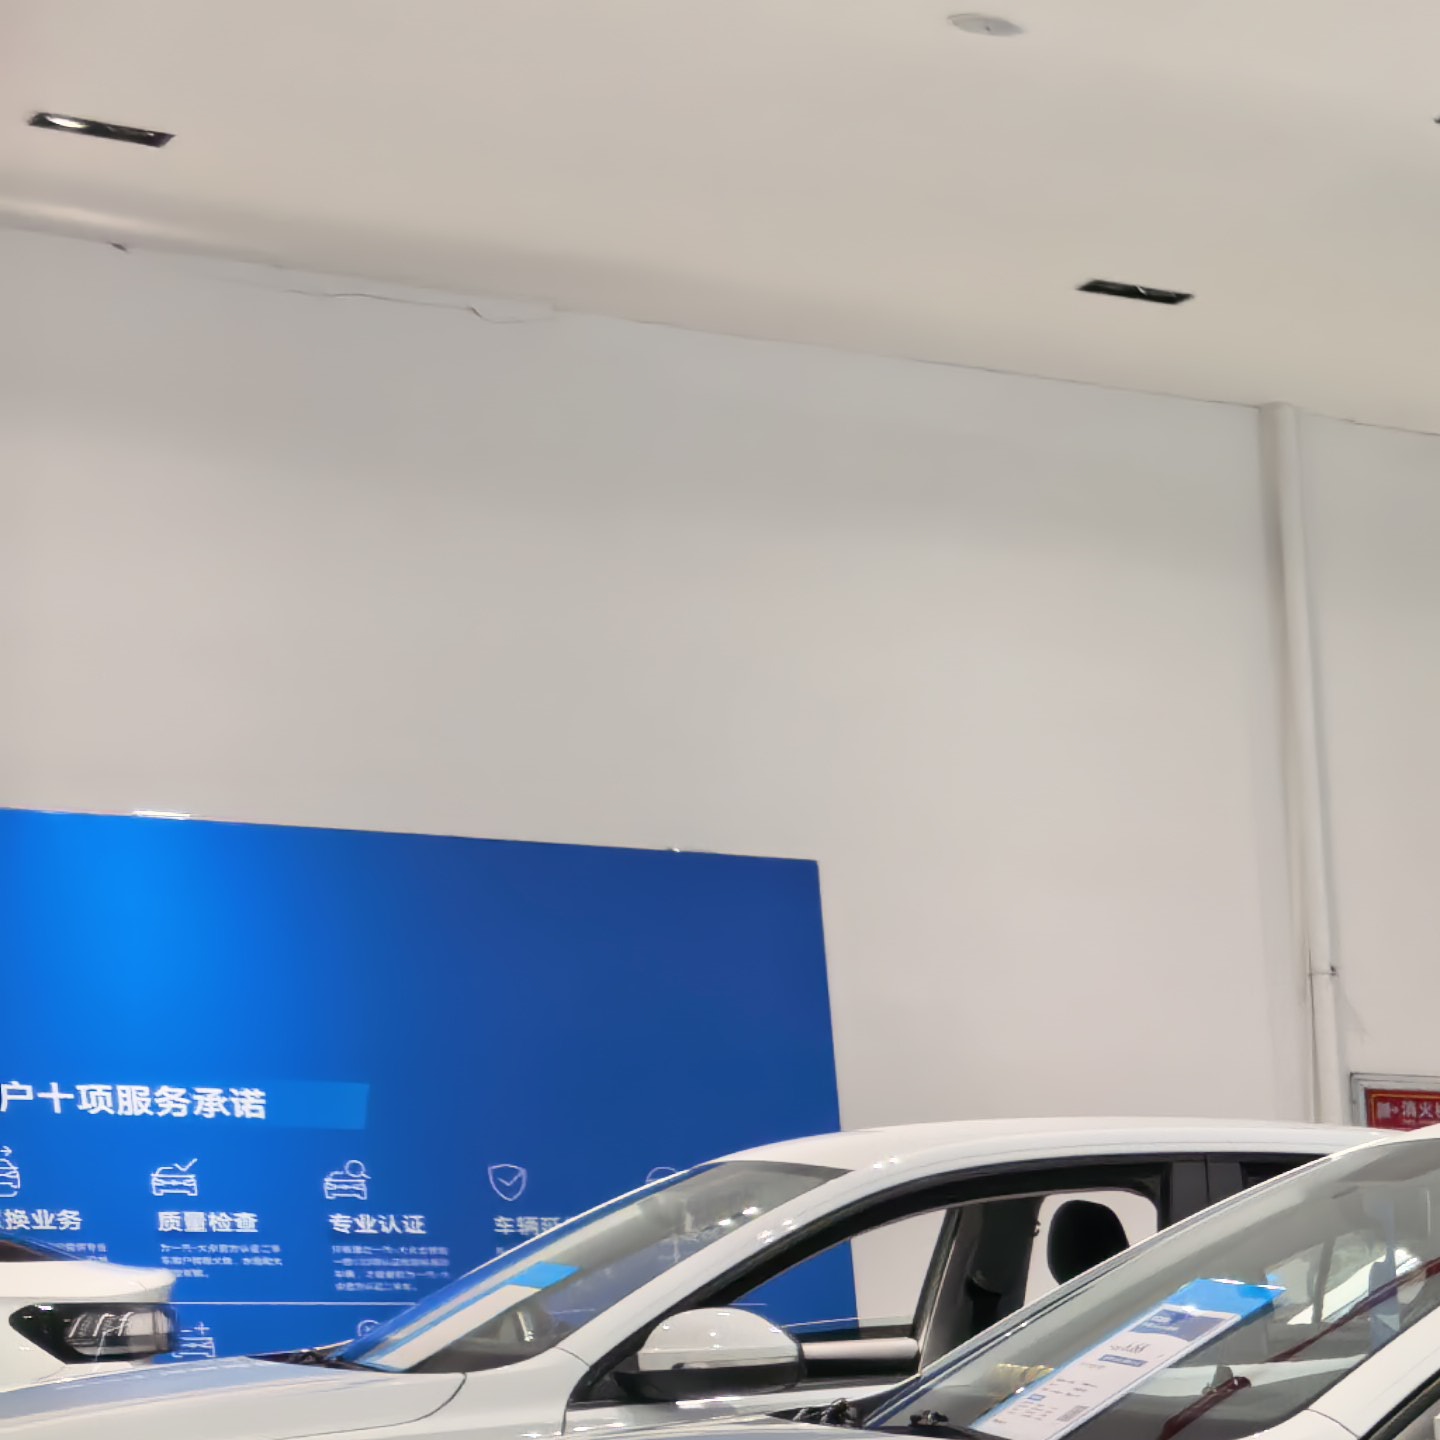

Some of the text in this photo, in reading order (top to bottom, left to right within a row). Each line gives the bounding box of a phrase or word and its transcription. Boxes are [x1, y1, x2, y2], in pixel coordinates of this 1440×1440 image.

[0, 1080, 267, 1120] 户十项服务承诺
[0, 1208, 83, 1231] 换业务
[157, 1211, 259, 1233] 质量检查
[328, 1212, 428, 1235] 专业认证
